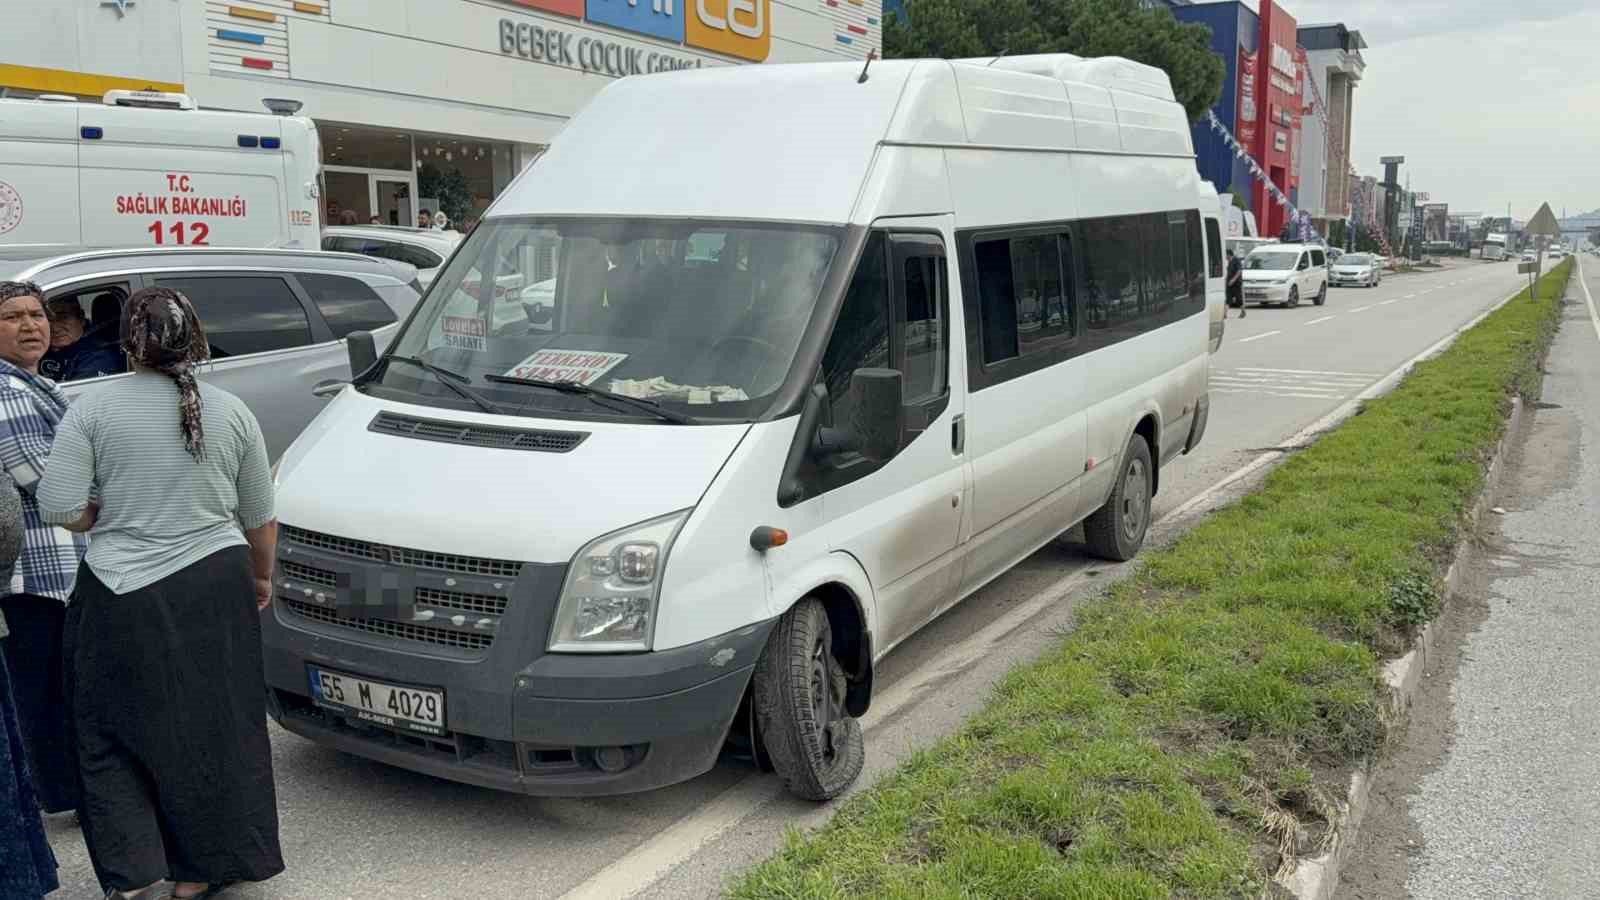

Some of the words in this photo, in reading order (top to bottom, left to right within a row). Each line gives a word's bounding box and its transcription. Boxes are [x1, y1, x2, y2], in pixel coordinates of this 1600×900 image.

[499, 19, 573, 66] BEBEK
[166, 174, 194, 193] T.C.
[116, 192, 169, 214] SAĞLIK
[172, 195, 246, 217] BAKANLIĞI
[148, 221, 210, 246] 112
[320, 675, 345, 702] 55
[358, 682, 373, 709] M
[387, 689, 437, 722] 4029
